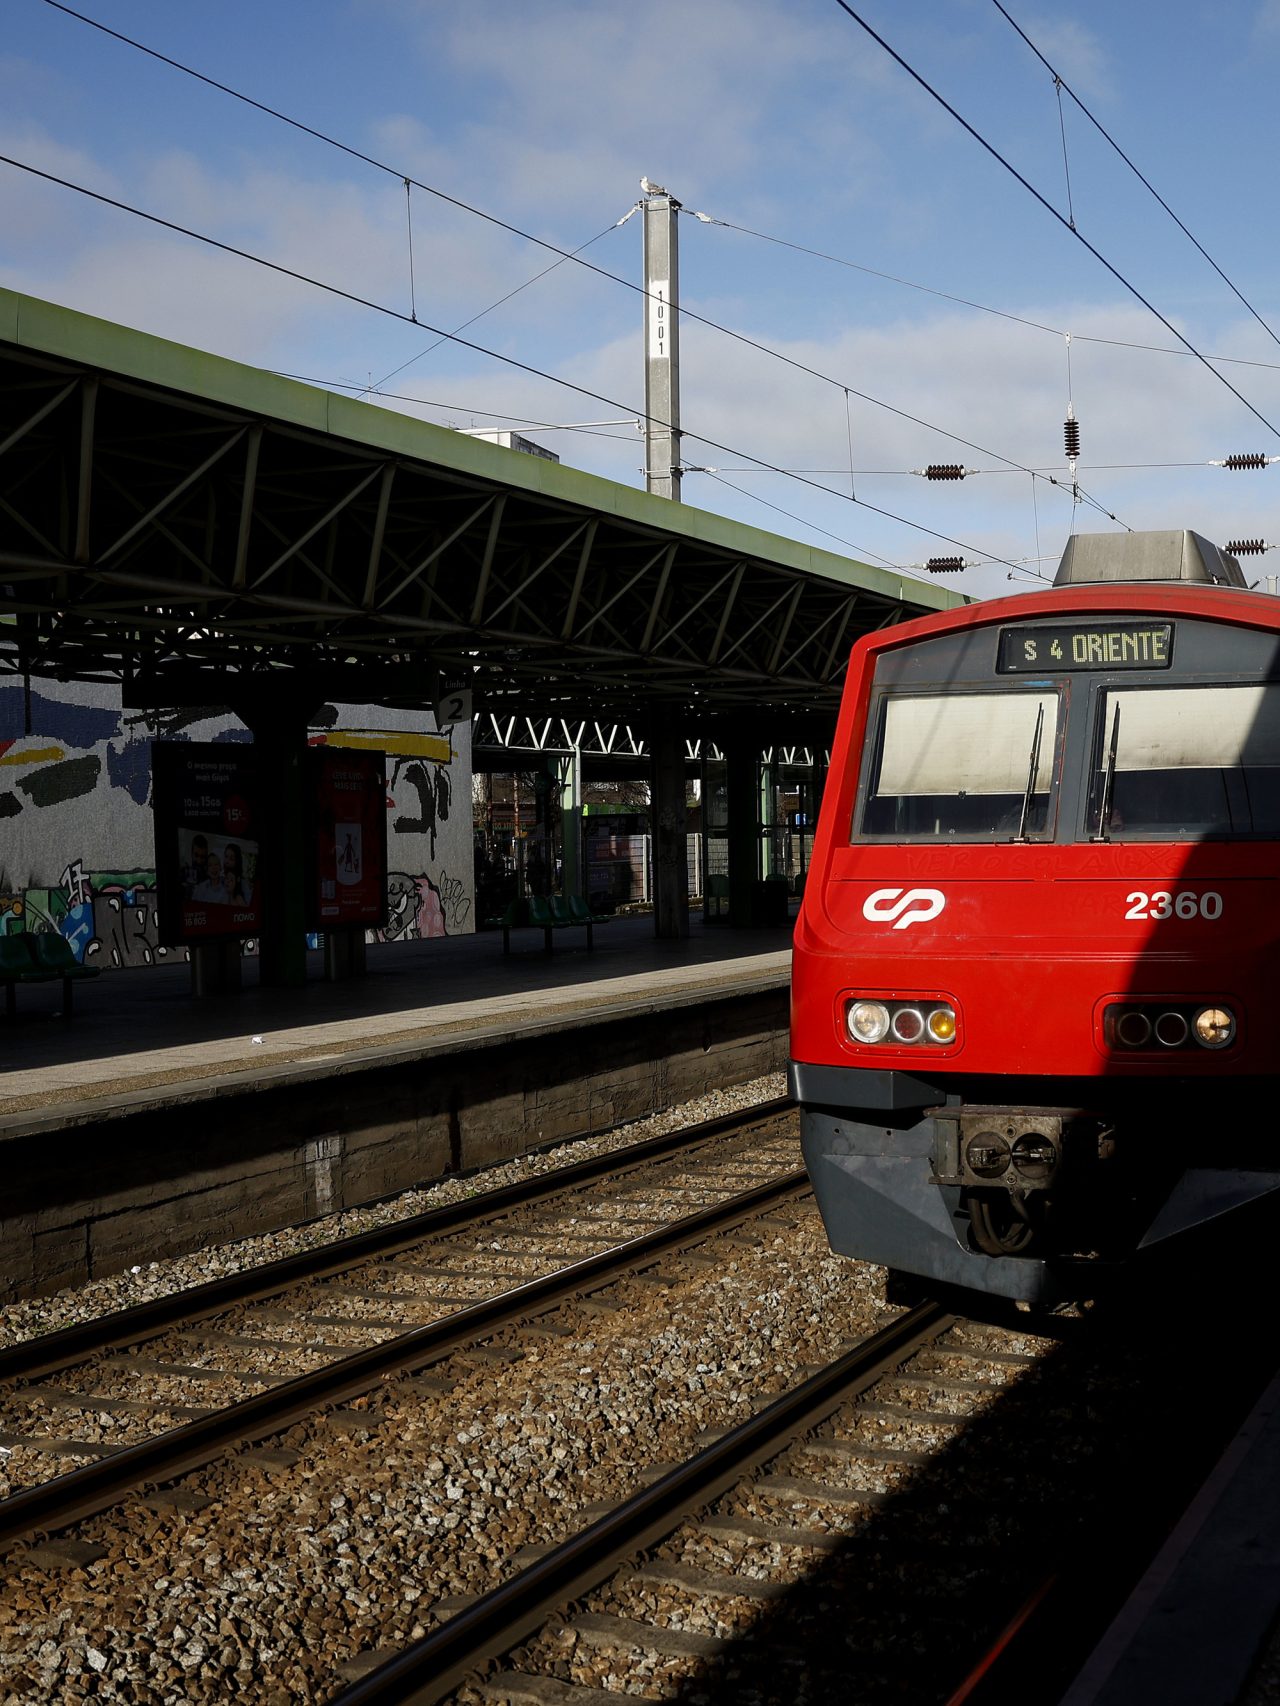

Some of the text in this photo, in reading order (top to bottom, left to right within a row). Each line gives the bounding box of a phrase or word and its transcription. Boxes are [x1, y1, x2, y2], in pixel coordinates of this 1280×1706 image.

[1024, 632, 1166, 663] S 4 ORIENTE
[447, 698, 463, 720] 2
[1124, 891, 1223, 920] 2360
